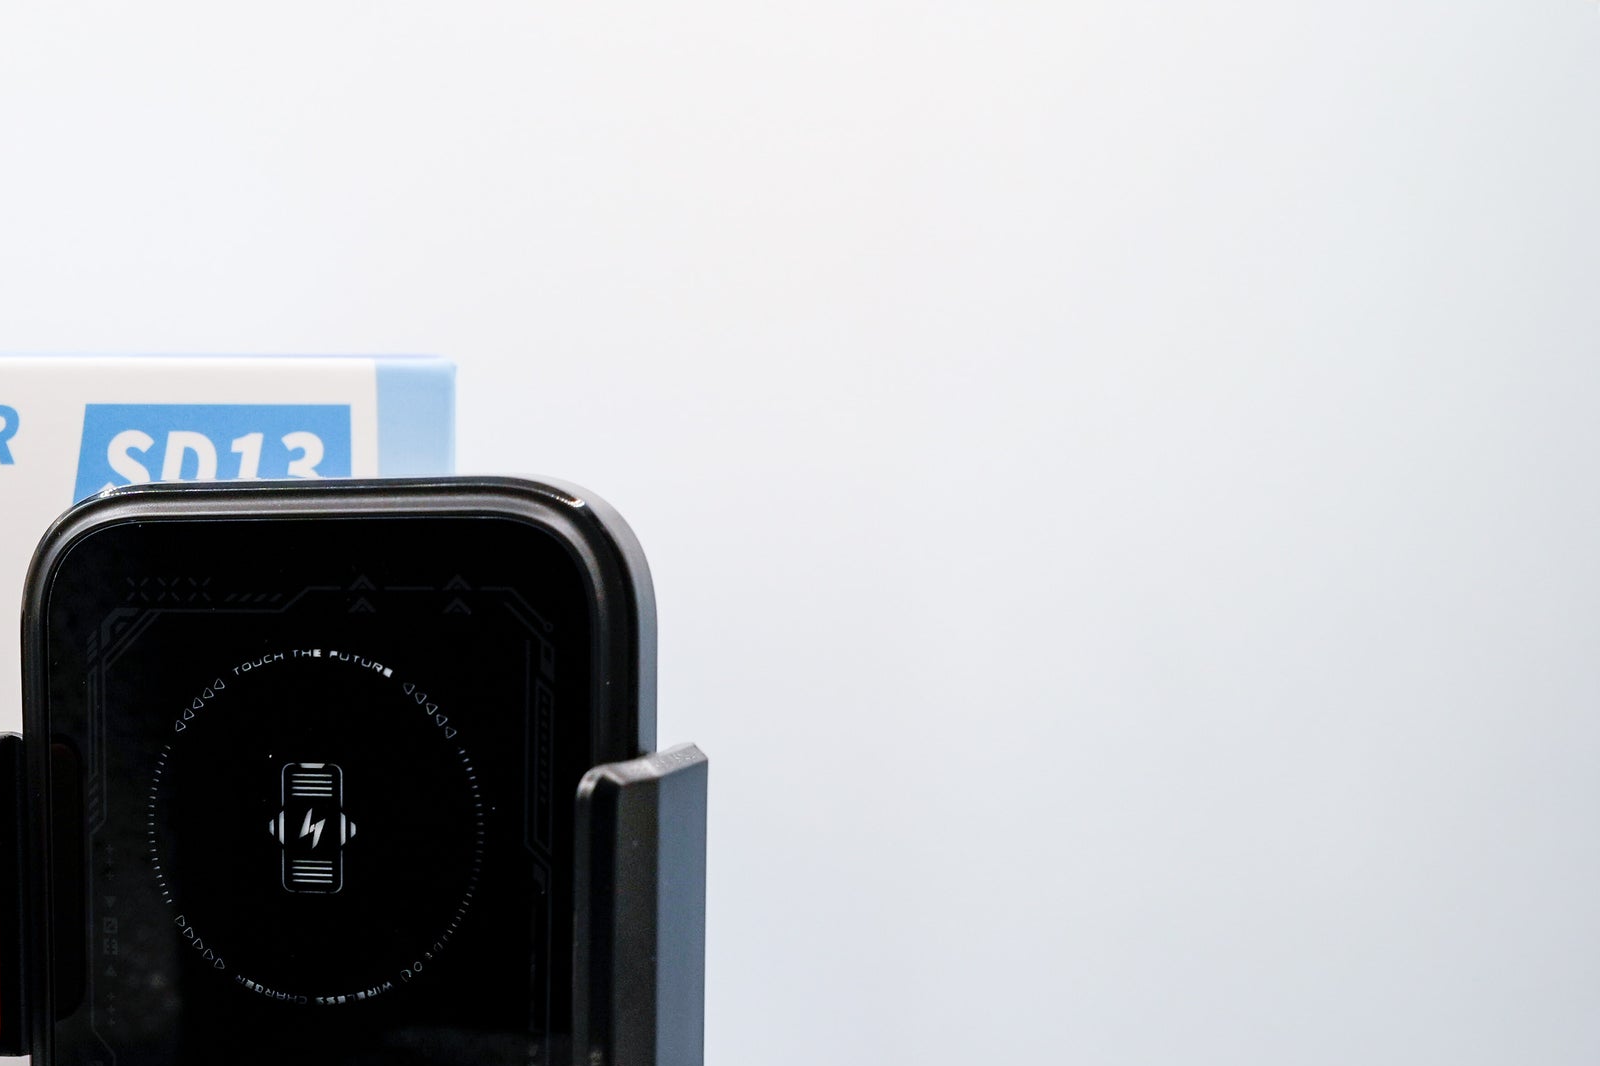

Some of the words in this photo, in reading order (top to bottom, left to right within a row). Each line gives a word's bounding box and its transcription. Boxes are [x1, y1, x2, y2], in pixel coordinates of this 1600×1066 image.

[101, 429, 325, 484] SD13
[232, 652, 285, 676] TOUCH
[292, 648, 322, 658] THE
[329, 650, 393, 678] FUTURE
